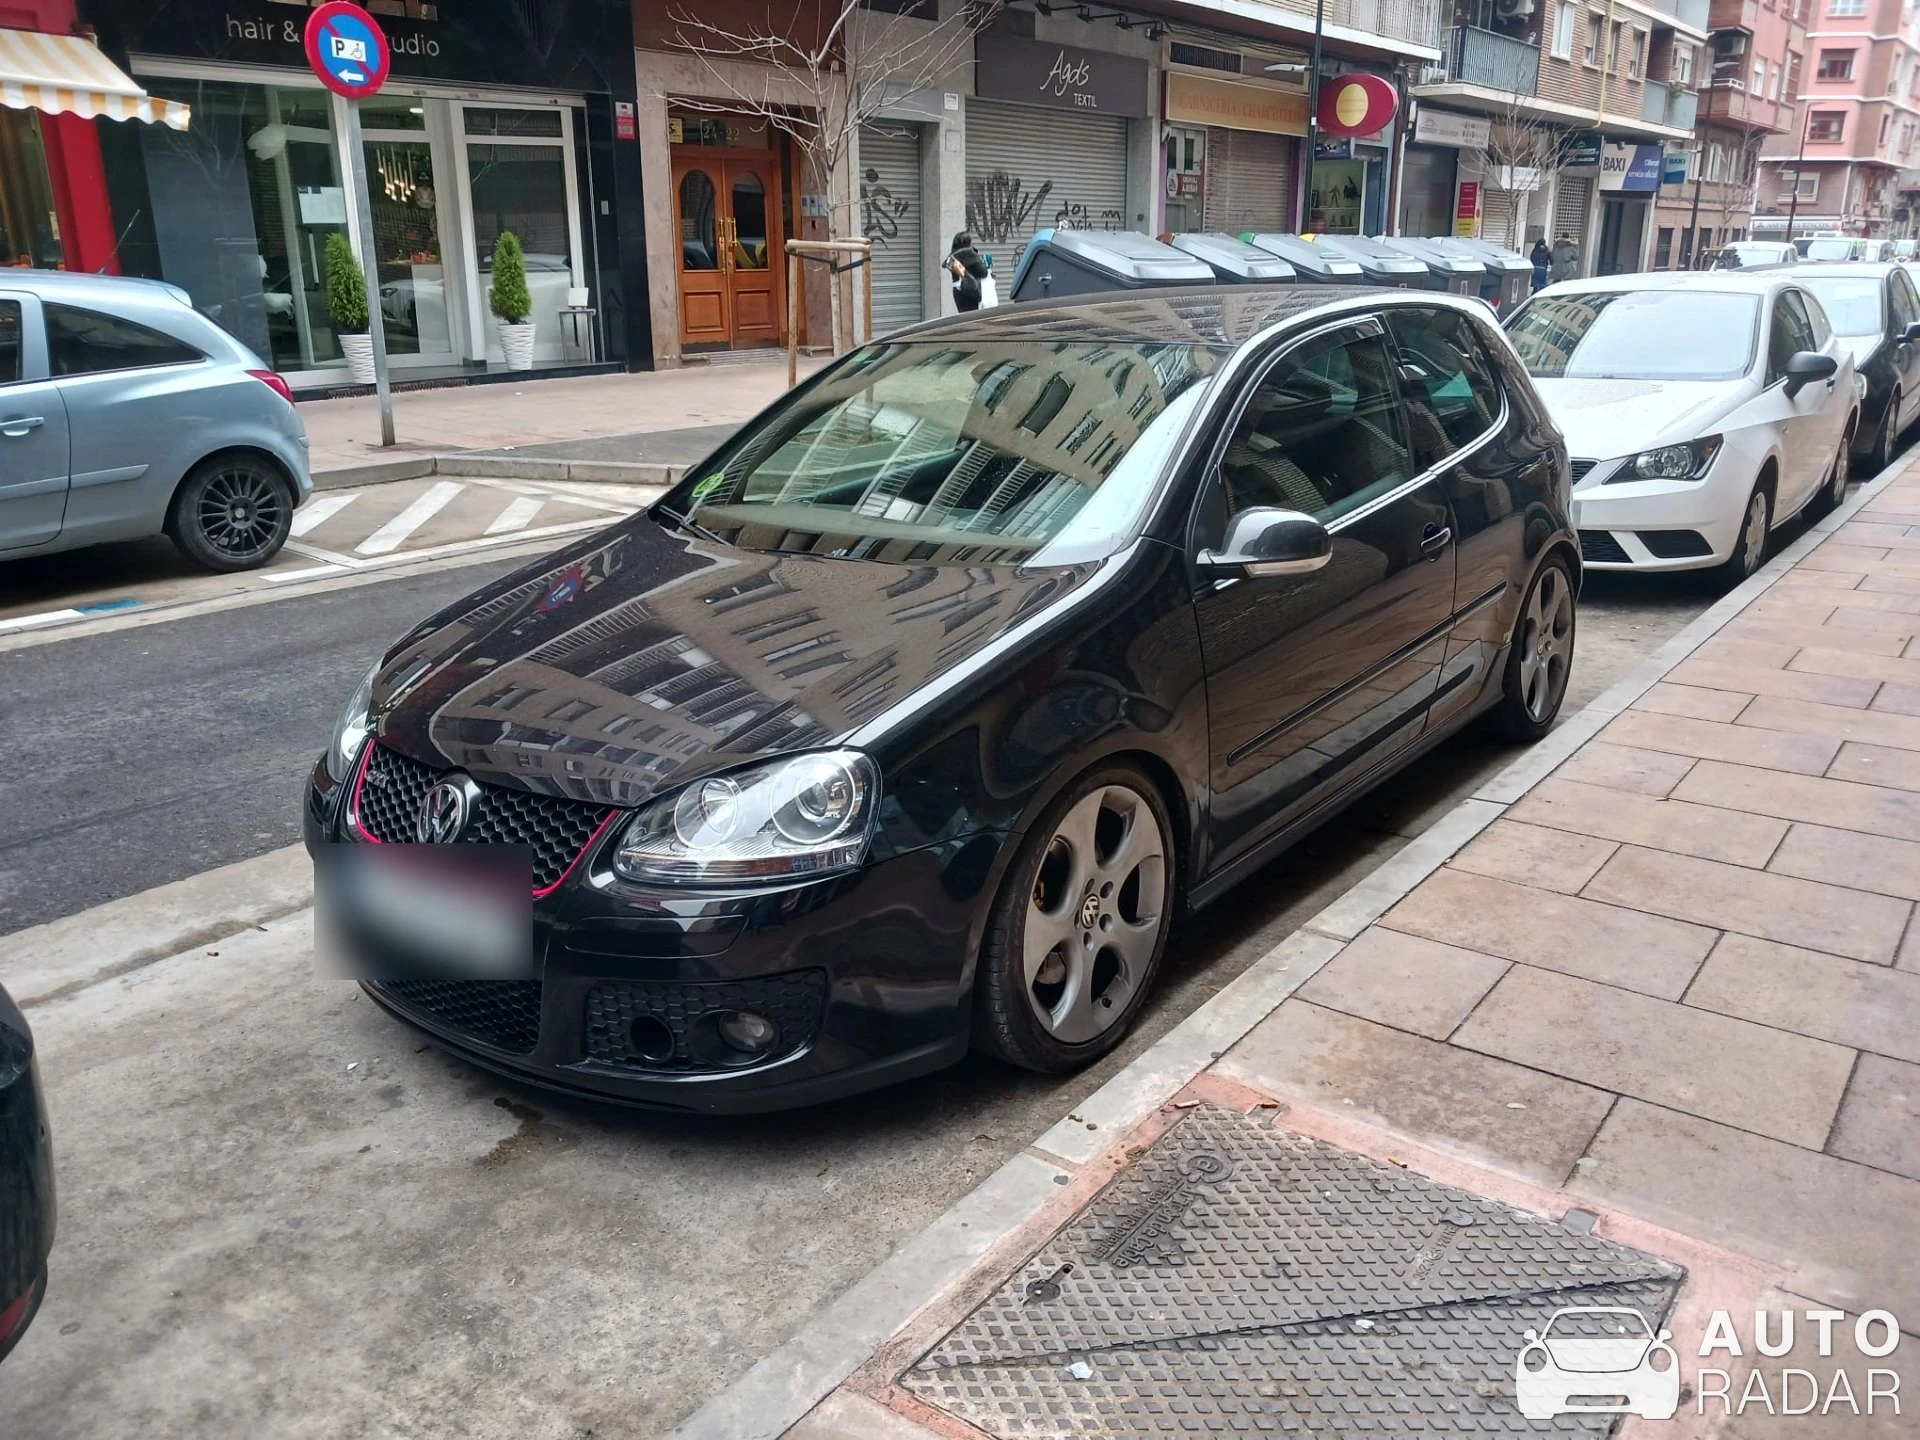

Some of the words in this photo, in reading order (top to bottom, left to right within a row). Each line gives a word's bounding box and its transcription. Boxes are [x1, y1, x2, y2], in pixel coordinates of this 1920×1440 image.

[225, 13, 275, 42] hair
[283, 20, 301, 44] &
[385, 33, 440, 57] udio
[335, 40, 345, 56] P
[1074, 93, 1098, 108] TEXTIL
[1602, 156, 1626, 172] BAXI
